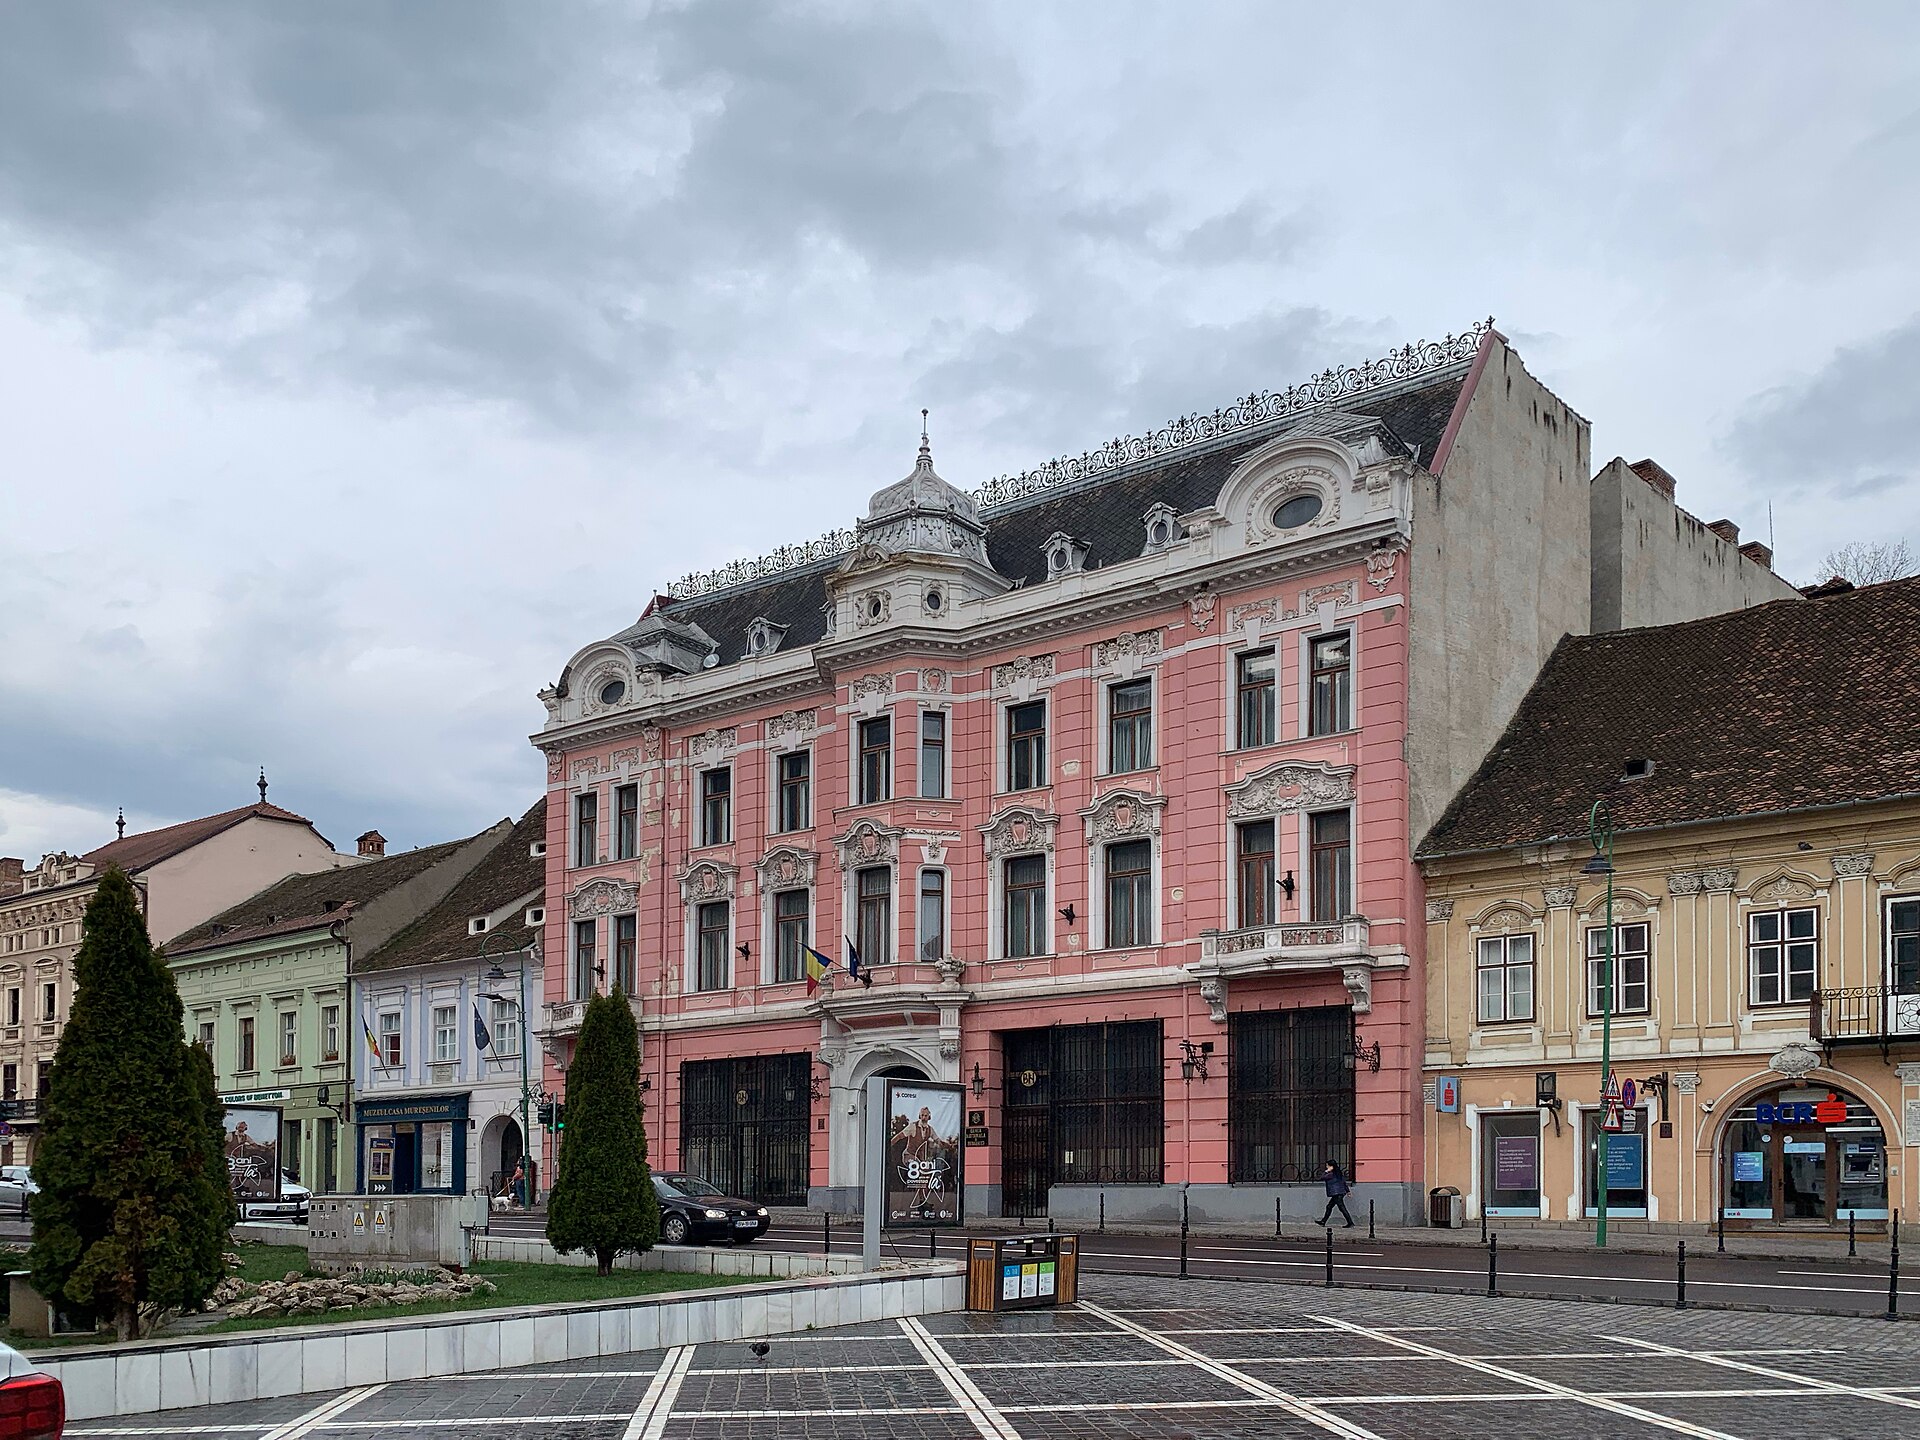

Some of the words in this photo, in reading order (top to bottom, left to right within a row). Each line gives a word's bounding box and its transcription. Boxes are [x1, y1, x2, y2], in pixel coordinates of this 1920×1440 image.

[1756, 1104, 1813, 1124] BCR
[908, 1160, 919, 1179] 8
[920, 1159, 936, 1169] ani
